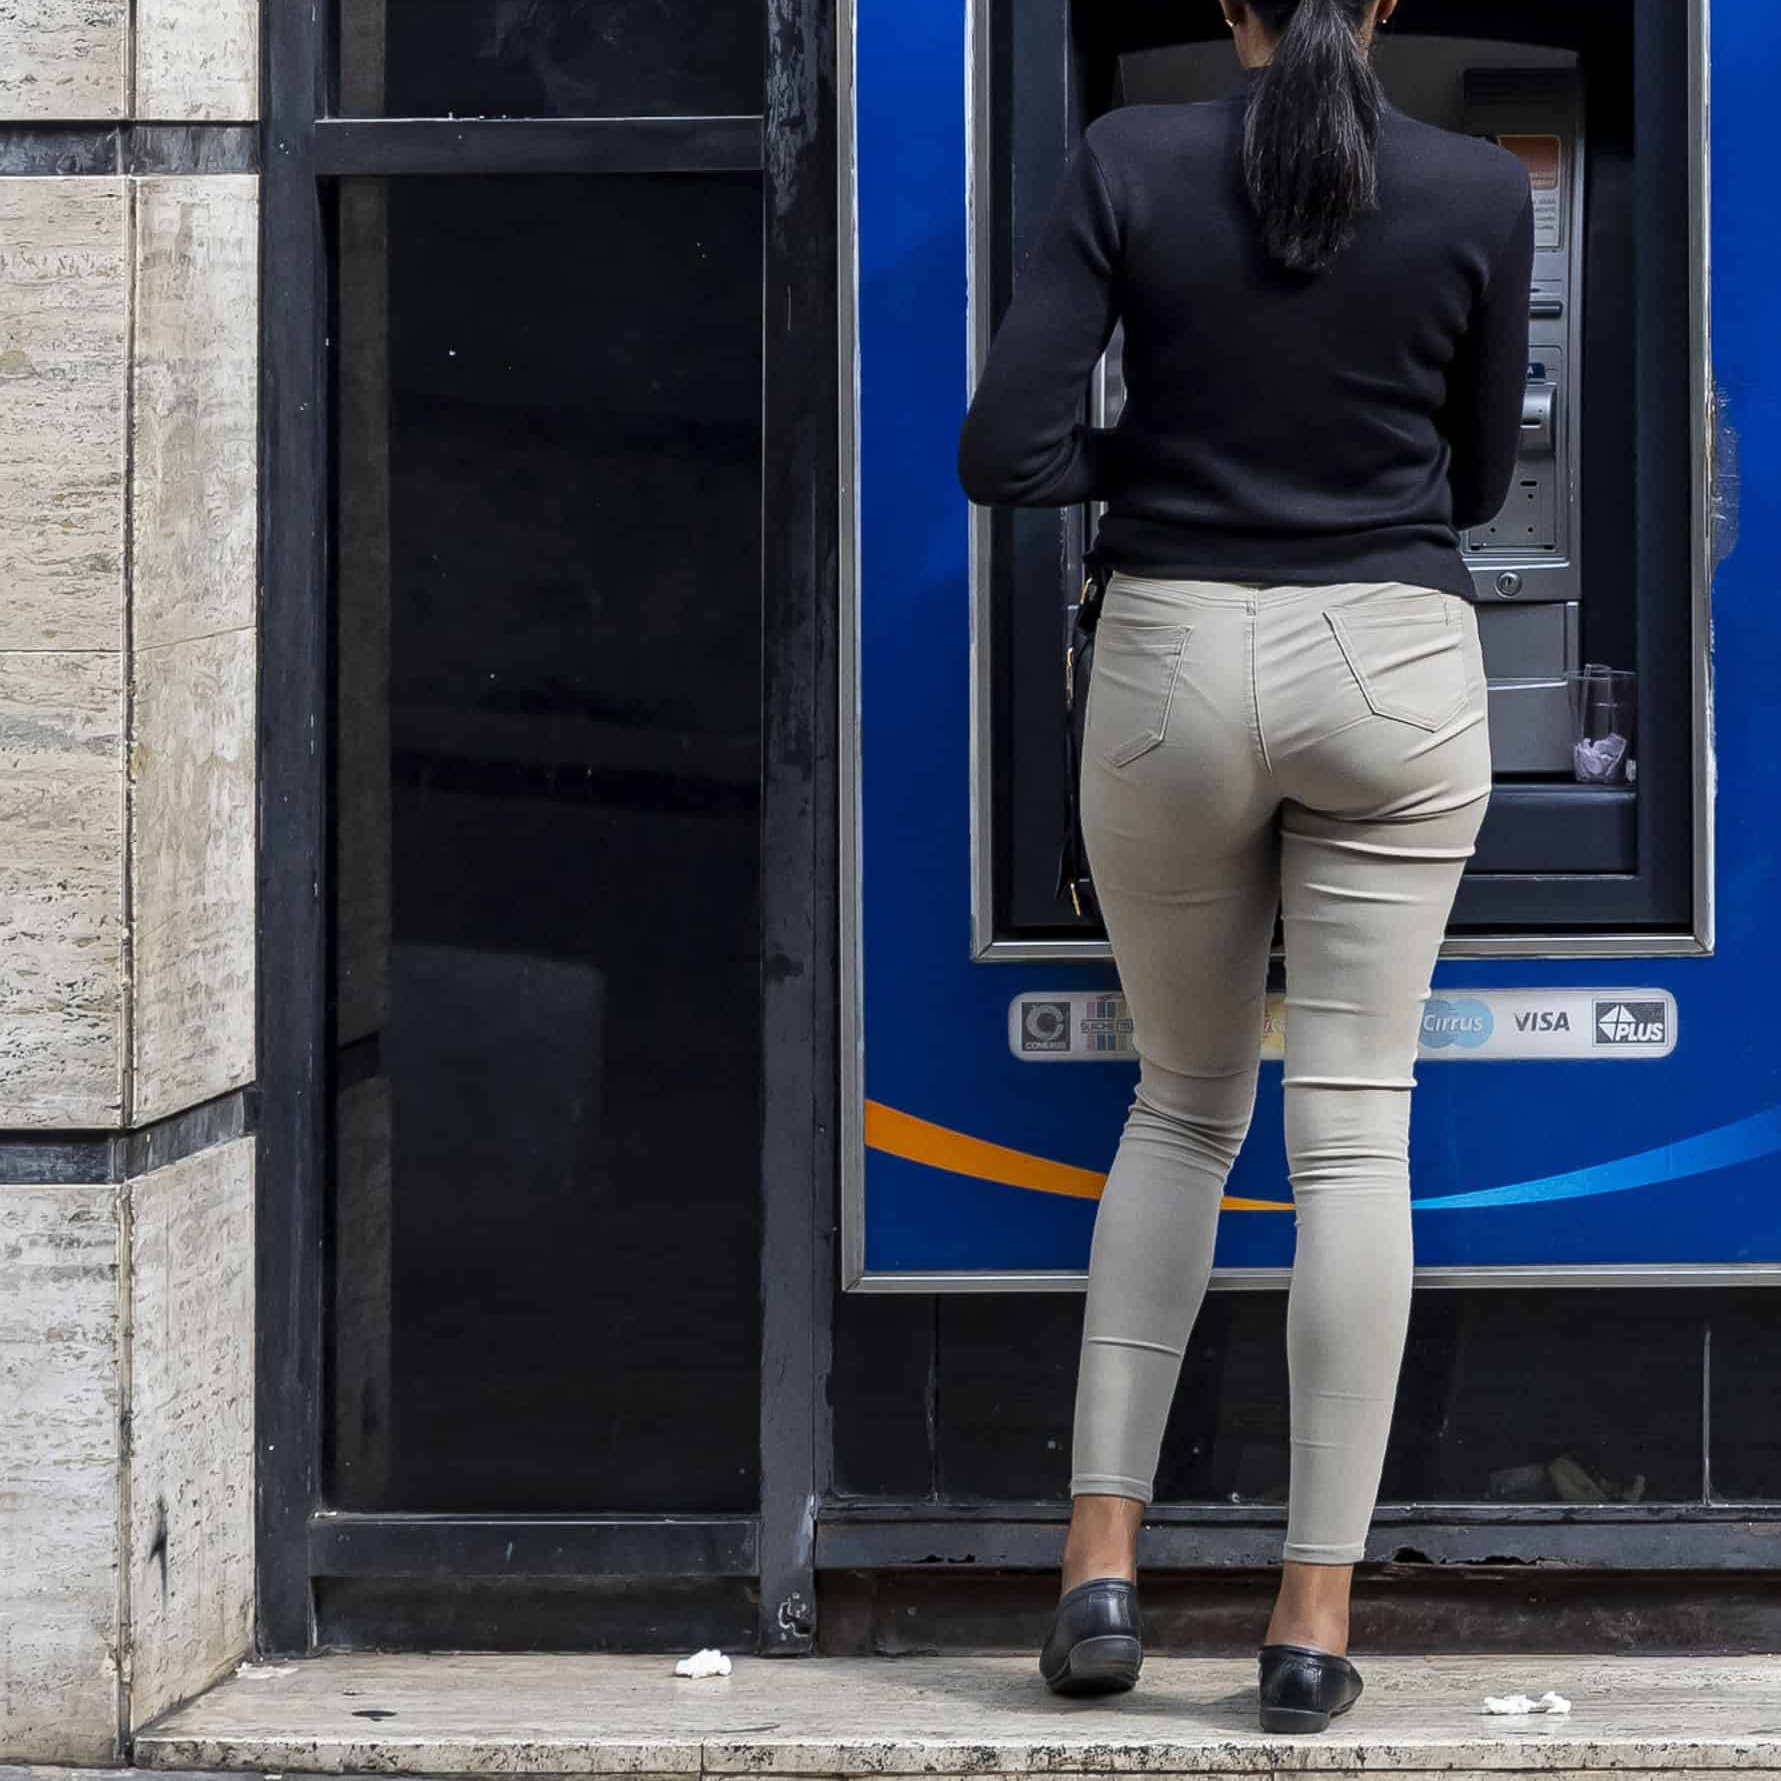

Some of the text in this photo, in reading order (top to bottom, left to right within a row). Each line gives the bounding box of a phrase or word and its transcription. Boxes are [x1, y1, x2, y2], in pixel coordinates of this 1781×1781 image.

[1423, 1014, 1485, 1032] Cirrus
[1514, 1010, 1571, 1033] VISA
[1615, 1022, 1664, 1042] PLUS
